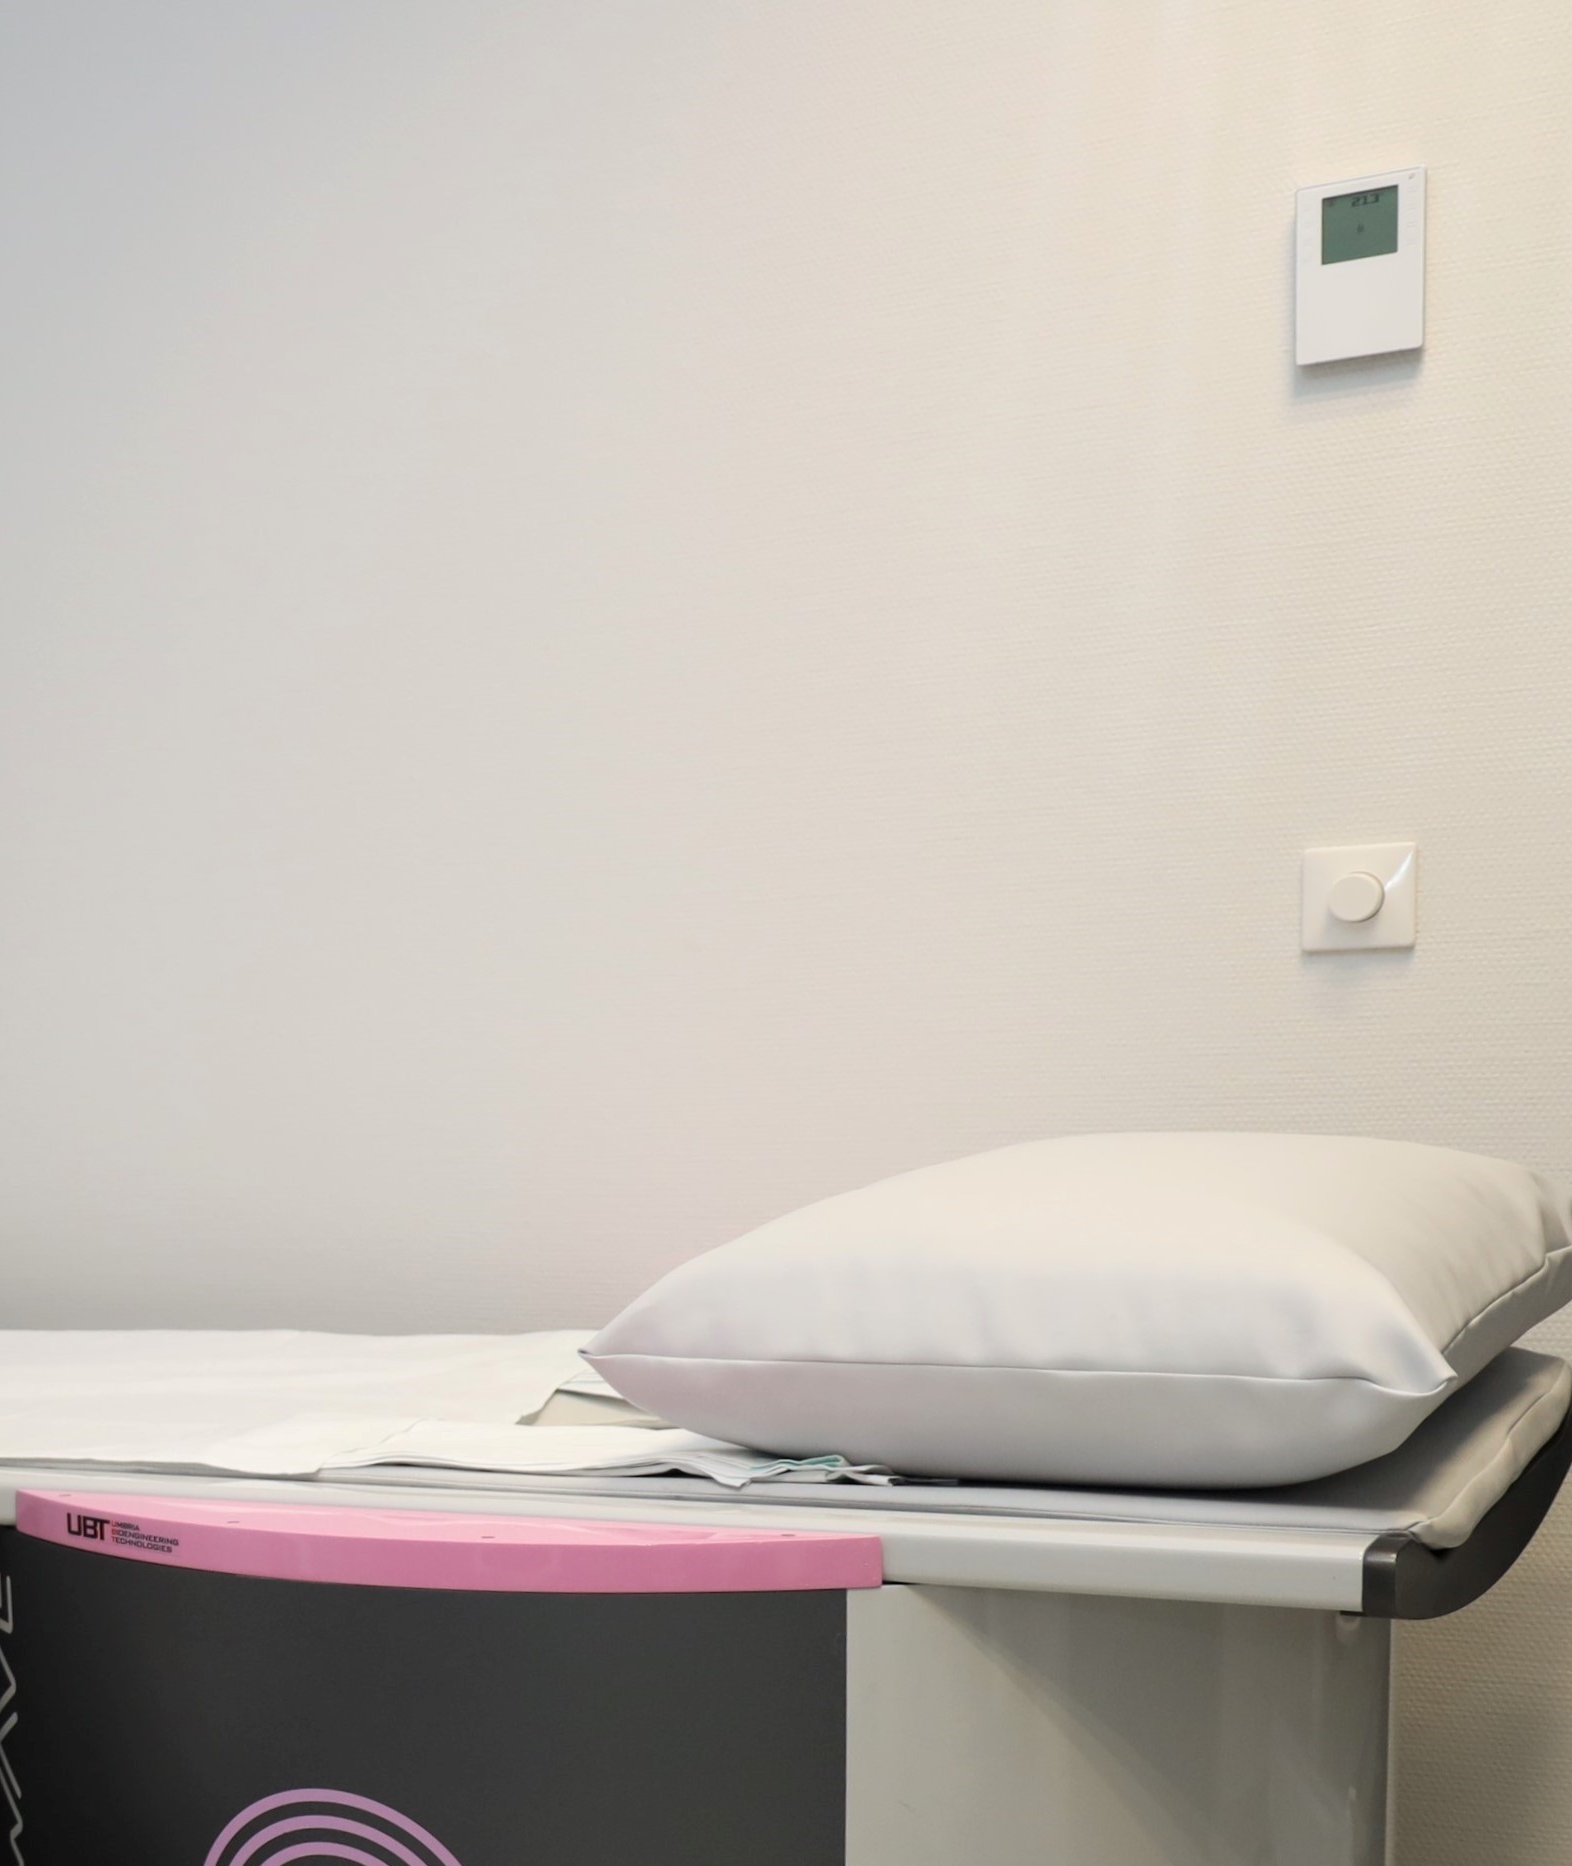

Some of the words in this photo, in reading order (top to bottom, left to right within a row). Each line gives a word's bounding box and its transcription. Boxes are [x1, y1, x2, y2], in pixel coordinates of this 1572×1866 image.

[66, 1512, 110, 1541] UBT
[111, 1520, 140, 1532] UMBRIA
[111, 1529, 179, 1546] BIOENGINEERING
[112, 1536, 173, 1553] TECHNOLOGIES
